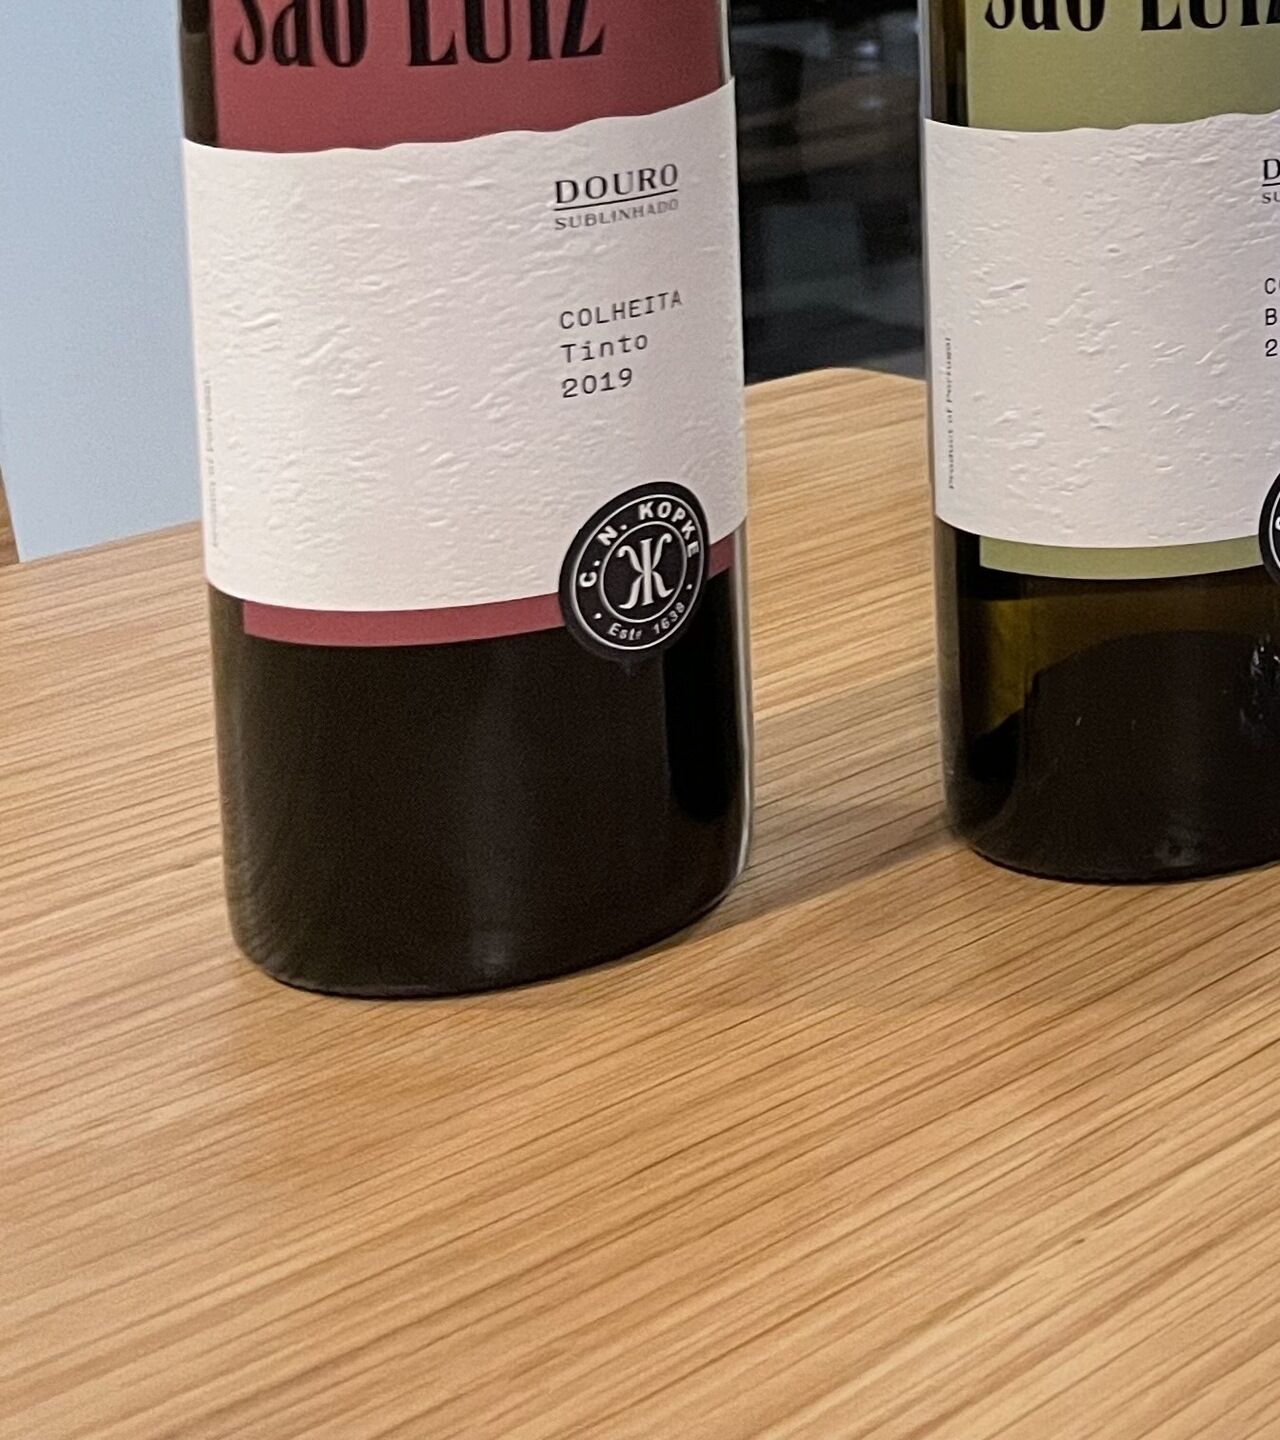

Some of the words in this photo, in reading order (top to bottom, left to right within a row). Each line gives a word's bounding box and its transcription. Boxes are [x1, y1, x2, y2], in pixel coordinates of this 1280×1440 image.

[555, 163, 678, 204] DOURO
[555, 198, 679, 231] SUBLINHADO
[559, 289, 683, 330] COLHEITA
[560, 334, 649, 364] Tinto
[561, 367, 634, 399] 2019
[638, 501, 700, 558] KOPKE
